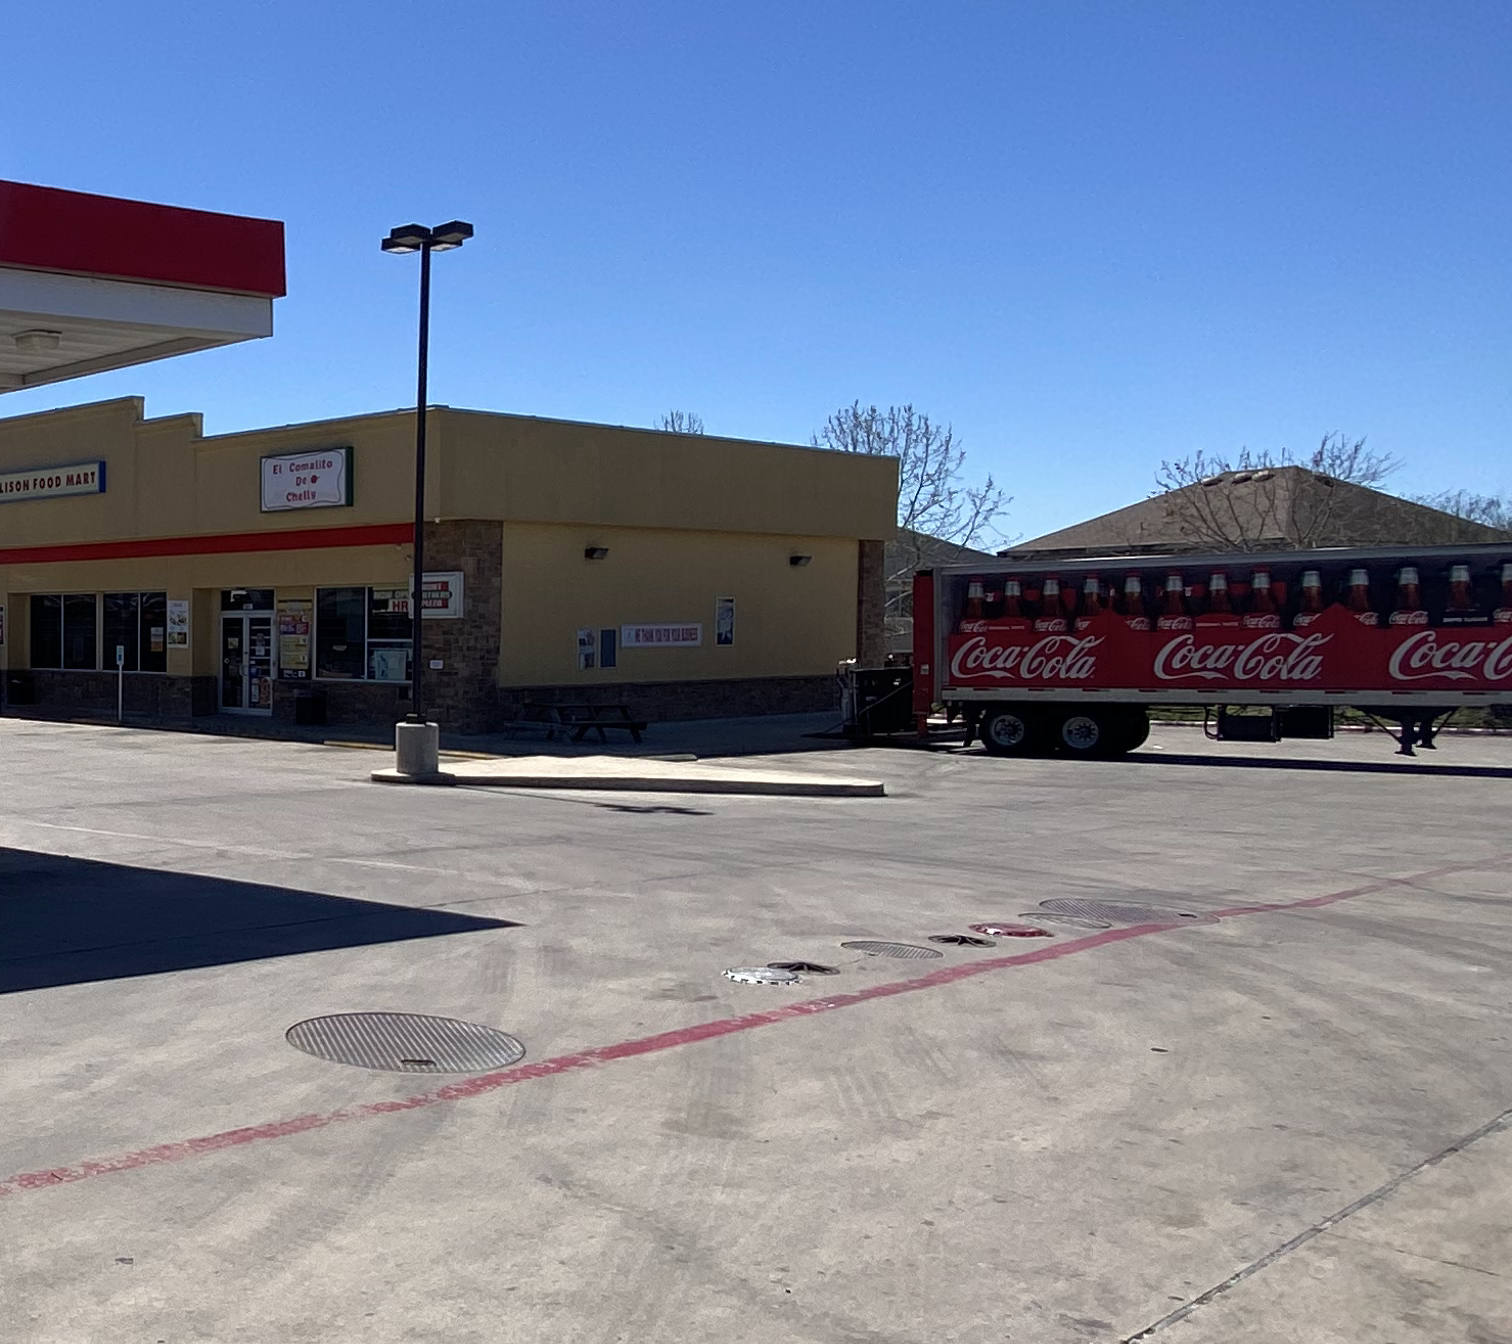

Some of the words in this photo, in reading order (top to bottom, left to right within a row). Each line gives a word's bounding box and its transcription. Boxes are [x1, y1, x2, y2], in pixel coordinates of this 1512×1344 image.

[33, 476, 61, 489] FOOD
[66, 472, 95, 486] MART
[951, 635, 1106, 679] Coca-Cola
[1153, 633, 1335, 680] Coca-Cola
[1389, 630, 1512, 681] Coca-C
